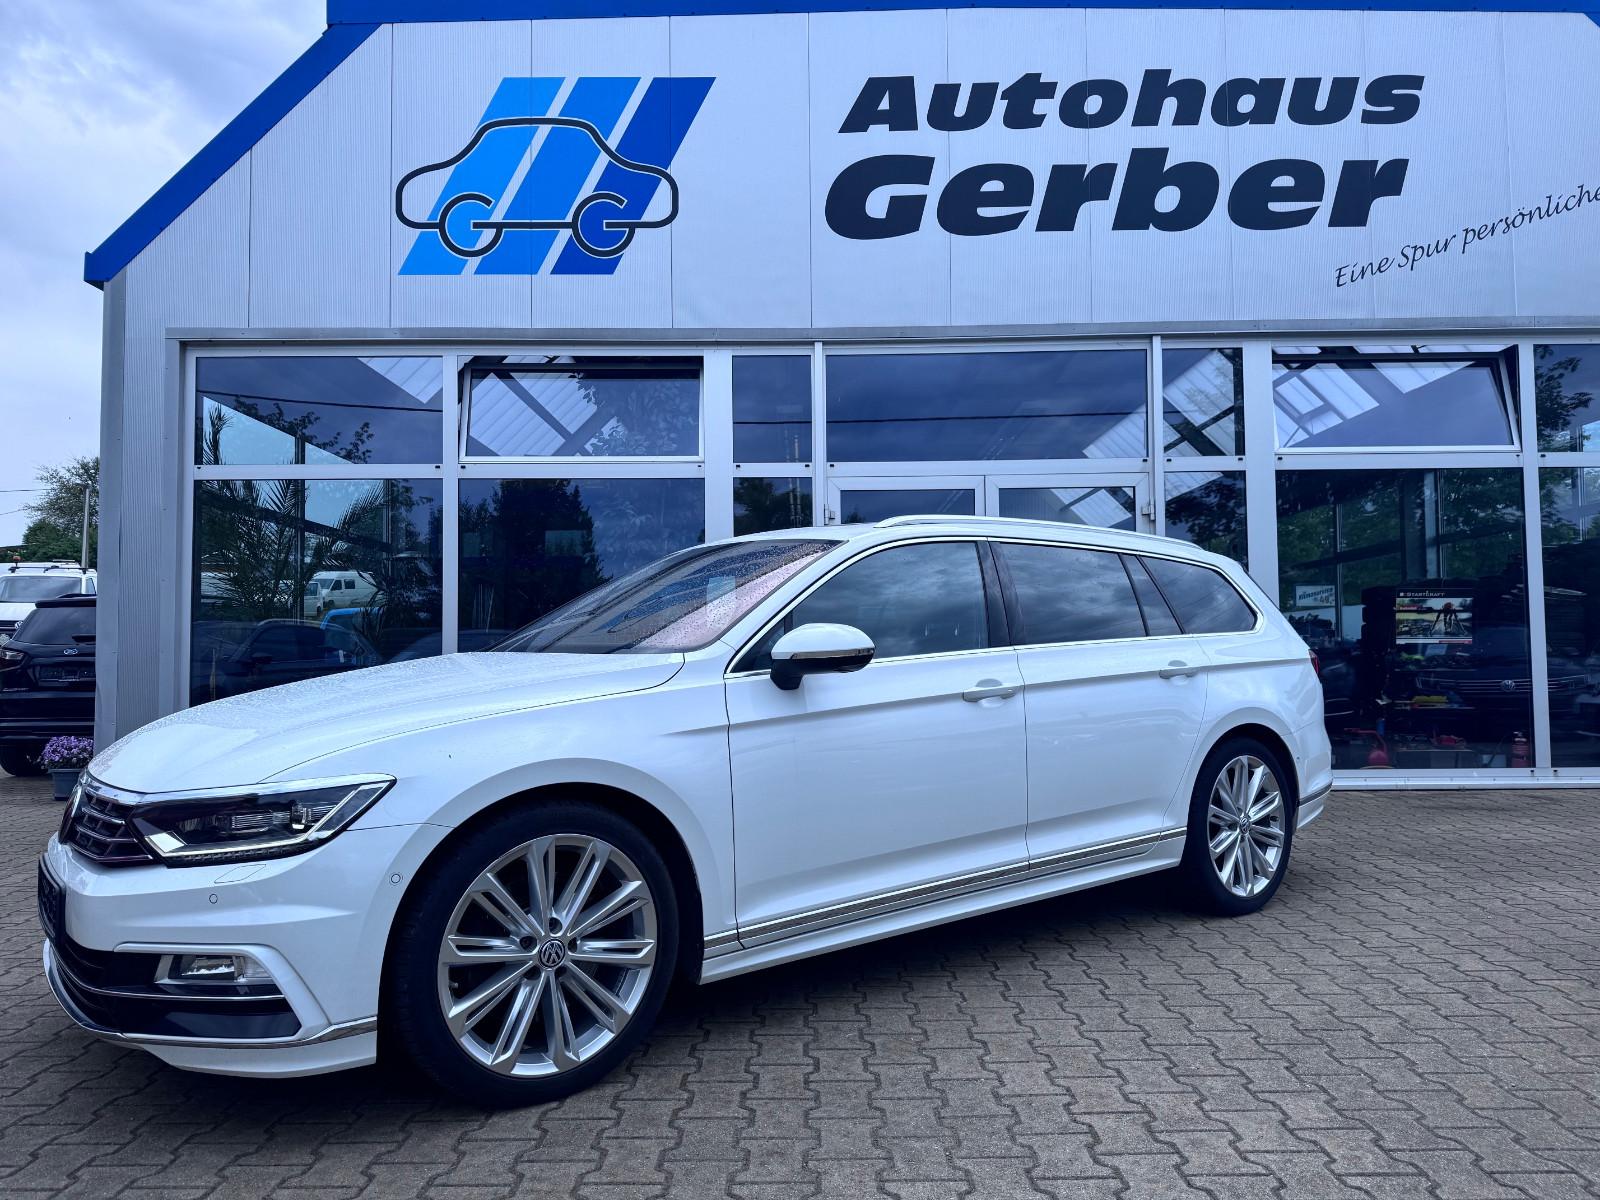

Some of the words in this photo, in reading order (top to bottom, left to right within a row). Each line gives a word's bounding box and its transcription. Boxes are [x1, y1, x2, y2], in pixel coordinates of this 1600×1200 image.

[838, 69, 1425, 134] Autohaus
[824, 147, 1410, 241] Gerber
[1334, 257, 1395, 288] Eine
[1397, 234, 1457, 272] Spur
